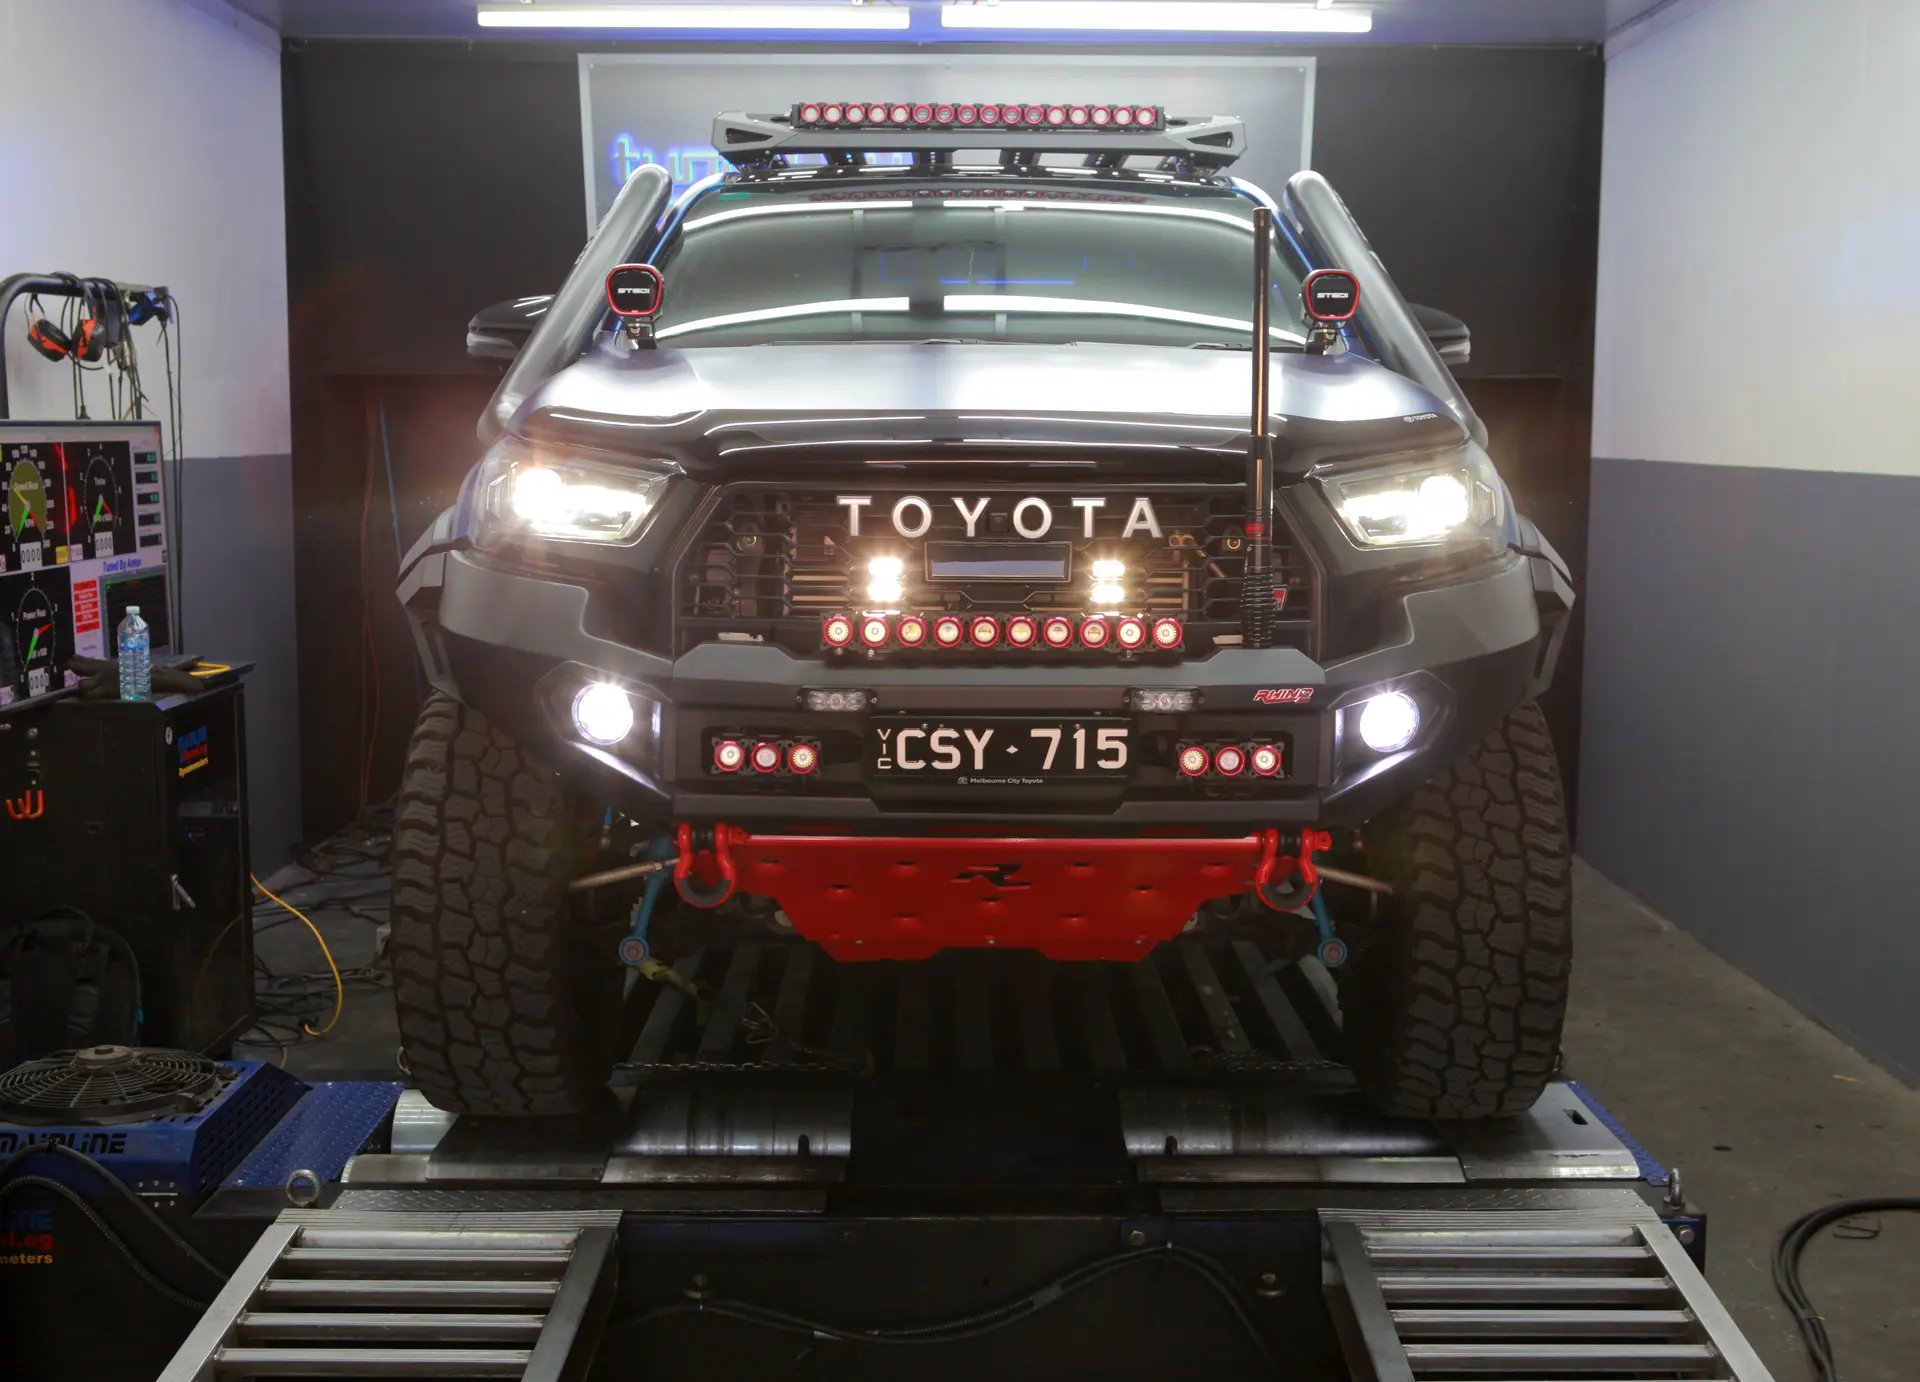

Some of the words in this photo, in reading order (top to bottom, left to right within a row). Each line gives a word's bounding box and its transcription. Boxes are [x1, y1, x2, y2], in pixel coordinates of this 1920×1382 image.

[836, 496, 1164, 539] TOYOTA
[896, 728, 994, 770] CSY
[1030, 728, 1129, 770] 715
[1007, 777, 1020, 785] City
[1021, 777, 1043, 785] Toyota
